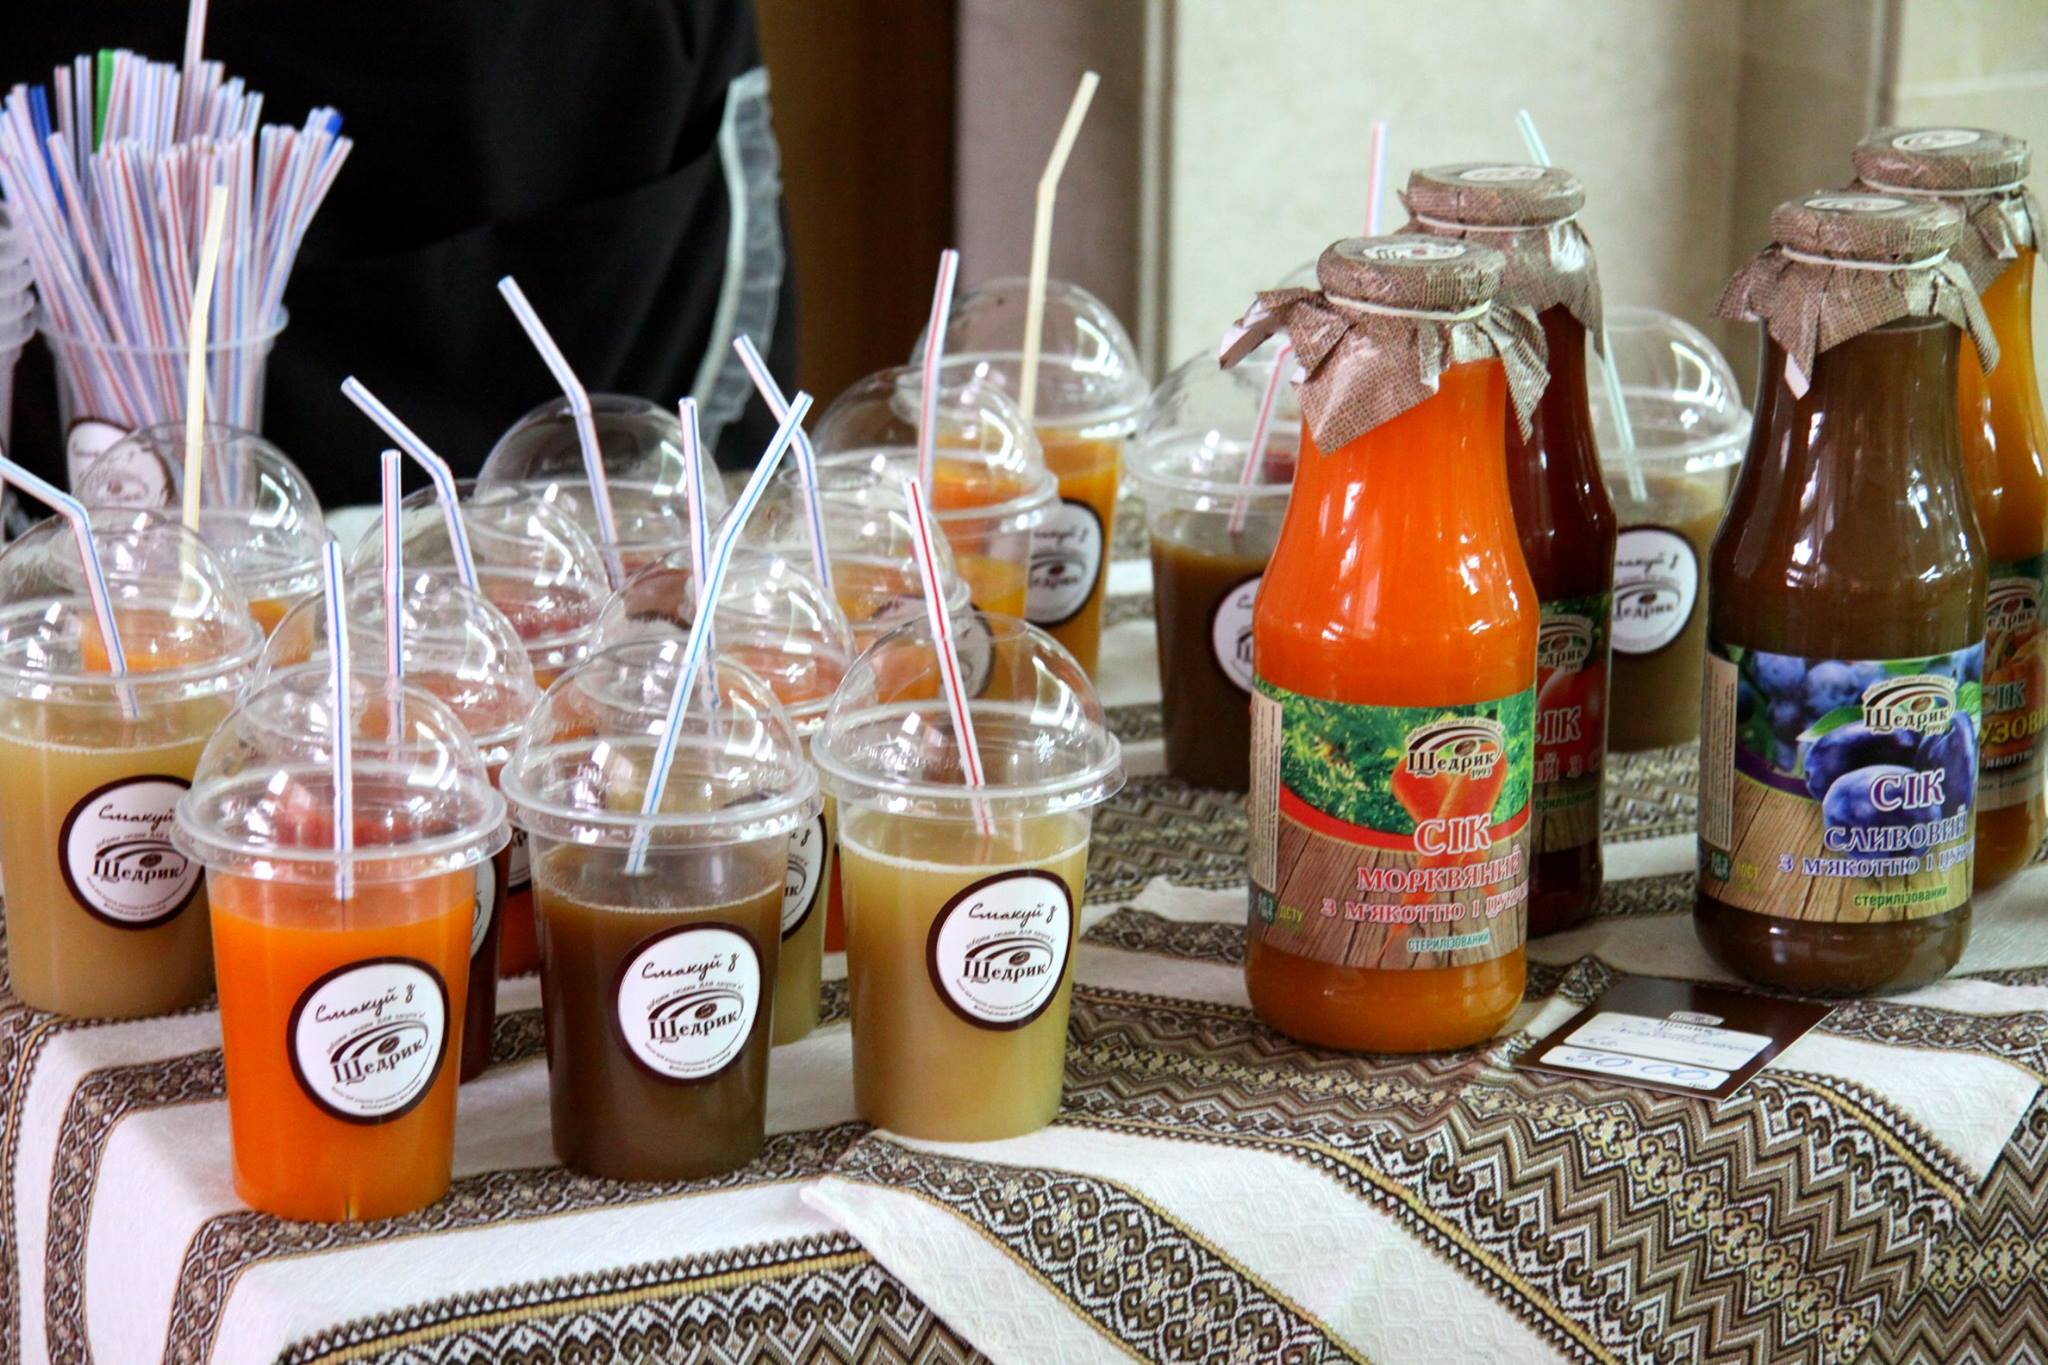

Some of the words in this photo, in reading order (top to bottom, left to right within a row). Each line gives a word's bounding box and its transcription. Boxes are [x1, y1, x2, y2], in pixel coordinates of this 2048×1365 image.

[1864, 708, 1948, 733] Щедрик
[1407, 752, 1494, 778] Щедрик
[1870, 768, 1945, 812] СІК
[98, 803, 175, 831] Смакуй
[1824, 803, 1968, 852] СЛИВОВИЙ
[1414, 812, 1492, 857] СІК
[93, 857, 181, 885] Щедрик
[1356, 843, 1522, 894] МОРКВЯНИЙ
[968, 902, 1043, 928] Смакуй
[641, 953, 722, 981] Смакуй
[962, 960, 1047, 985] Щедрик
[315, 986, 398, 1024] Смакуй
[648, 1010, 738, 1044] Щедрик
[332, 1039, 423, 1086] Щедрик
